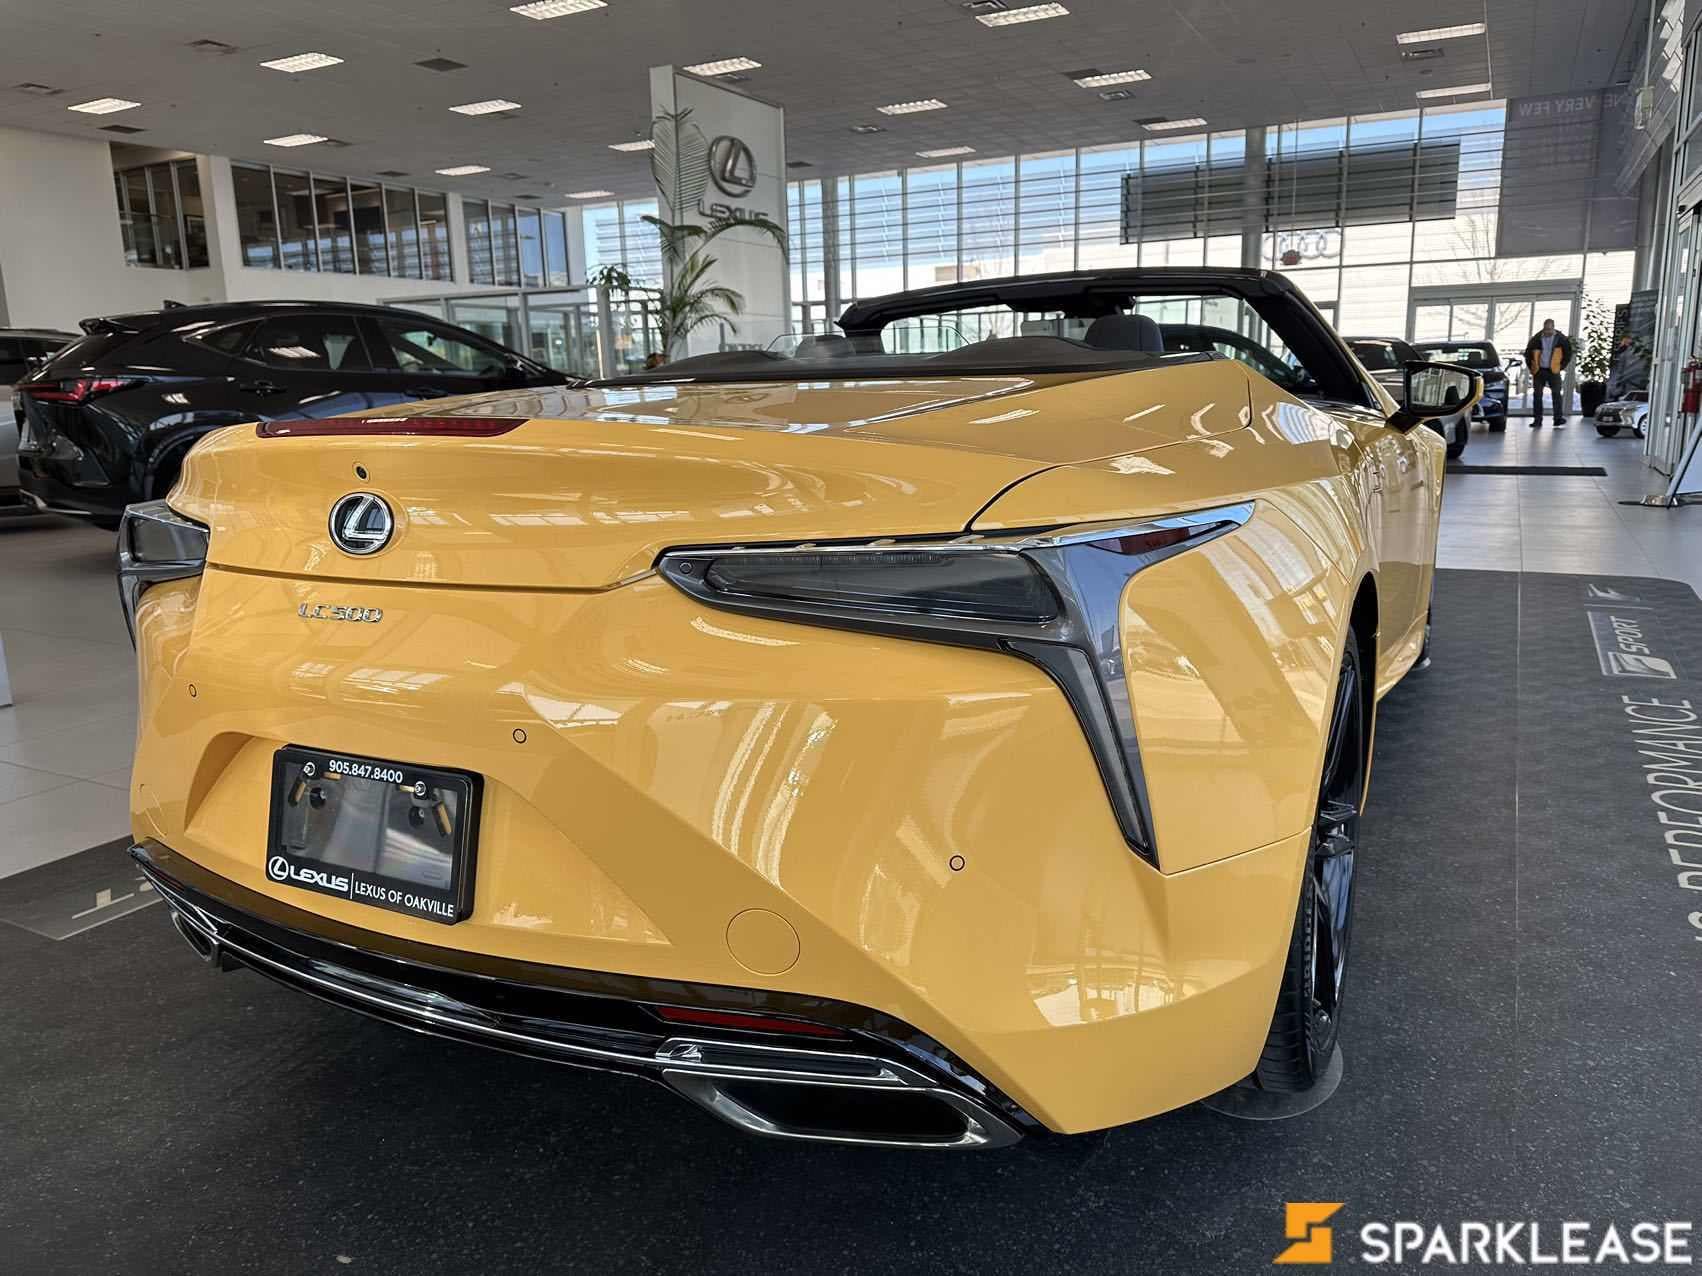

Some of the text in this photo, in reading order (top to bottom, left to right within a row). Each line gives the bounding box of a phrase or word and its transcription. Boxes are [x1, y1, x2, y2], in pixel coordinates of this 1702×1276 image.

[1609, 615, 1651, 655] SPORT
[328, 759, 403, 783] 905.847.8400
[1621, 695, 1702, 890] FORMANCE
[290, 865, 349, 892] LEXUS
[355, 881, 454, 917] LEXUS OF OAKVILLE
